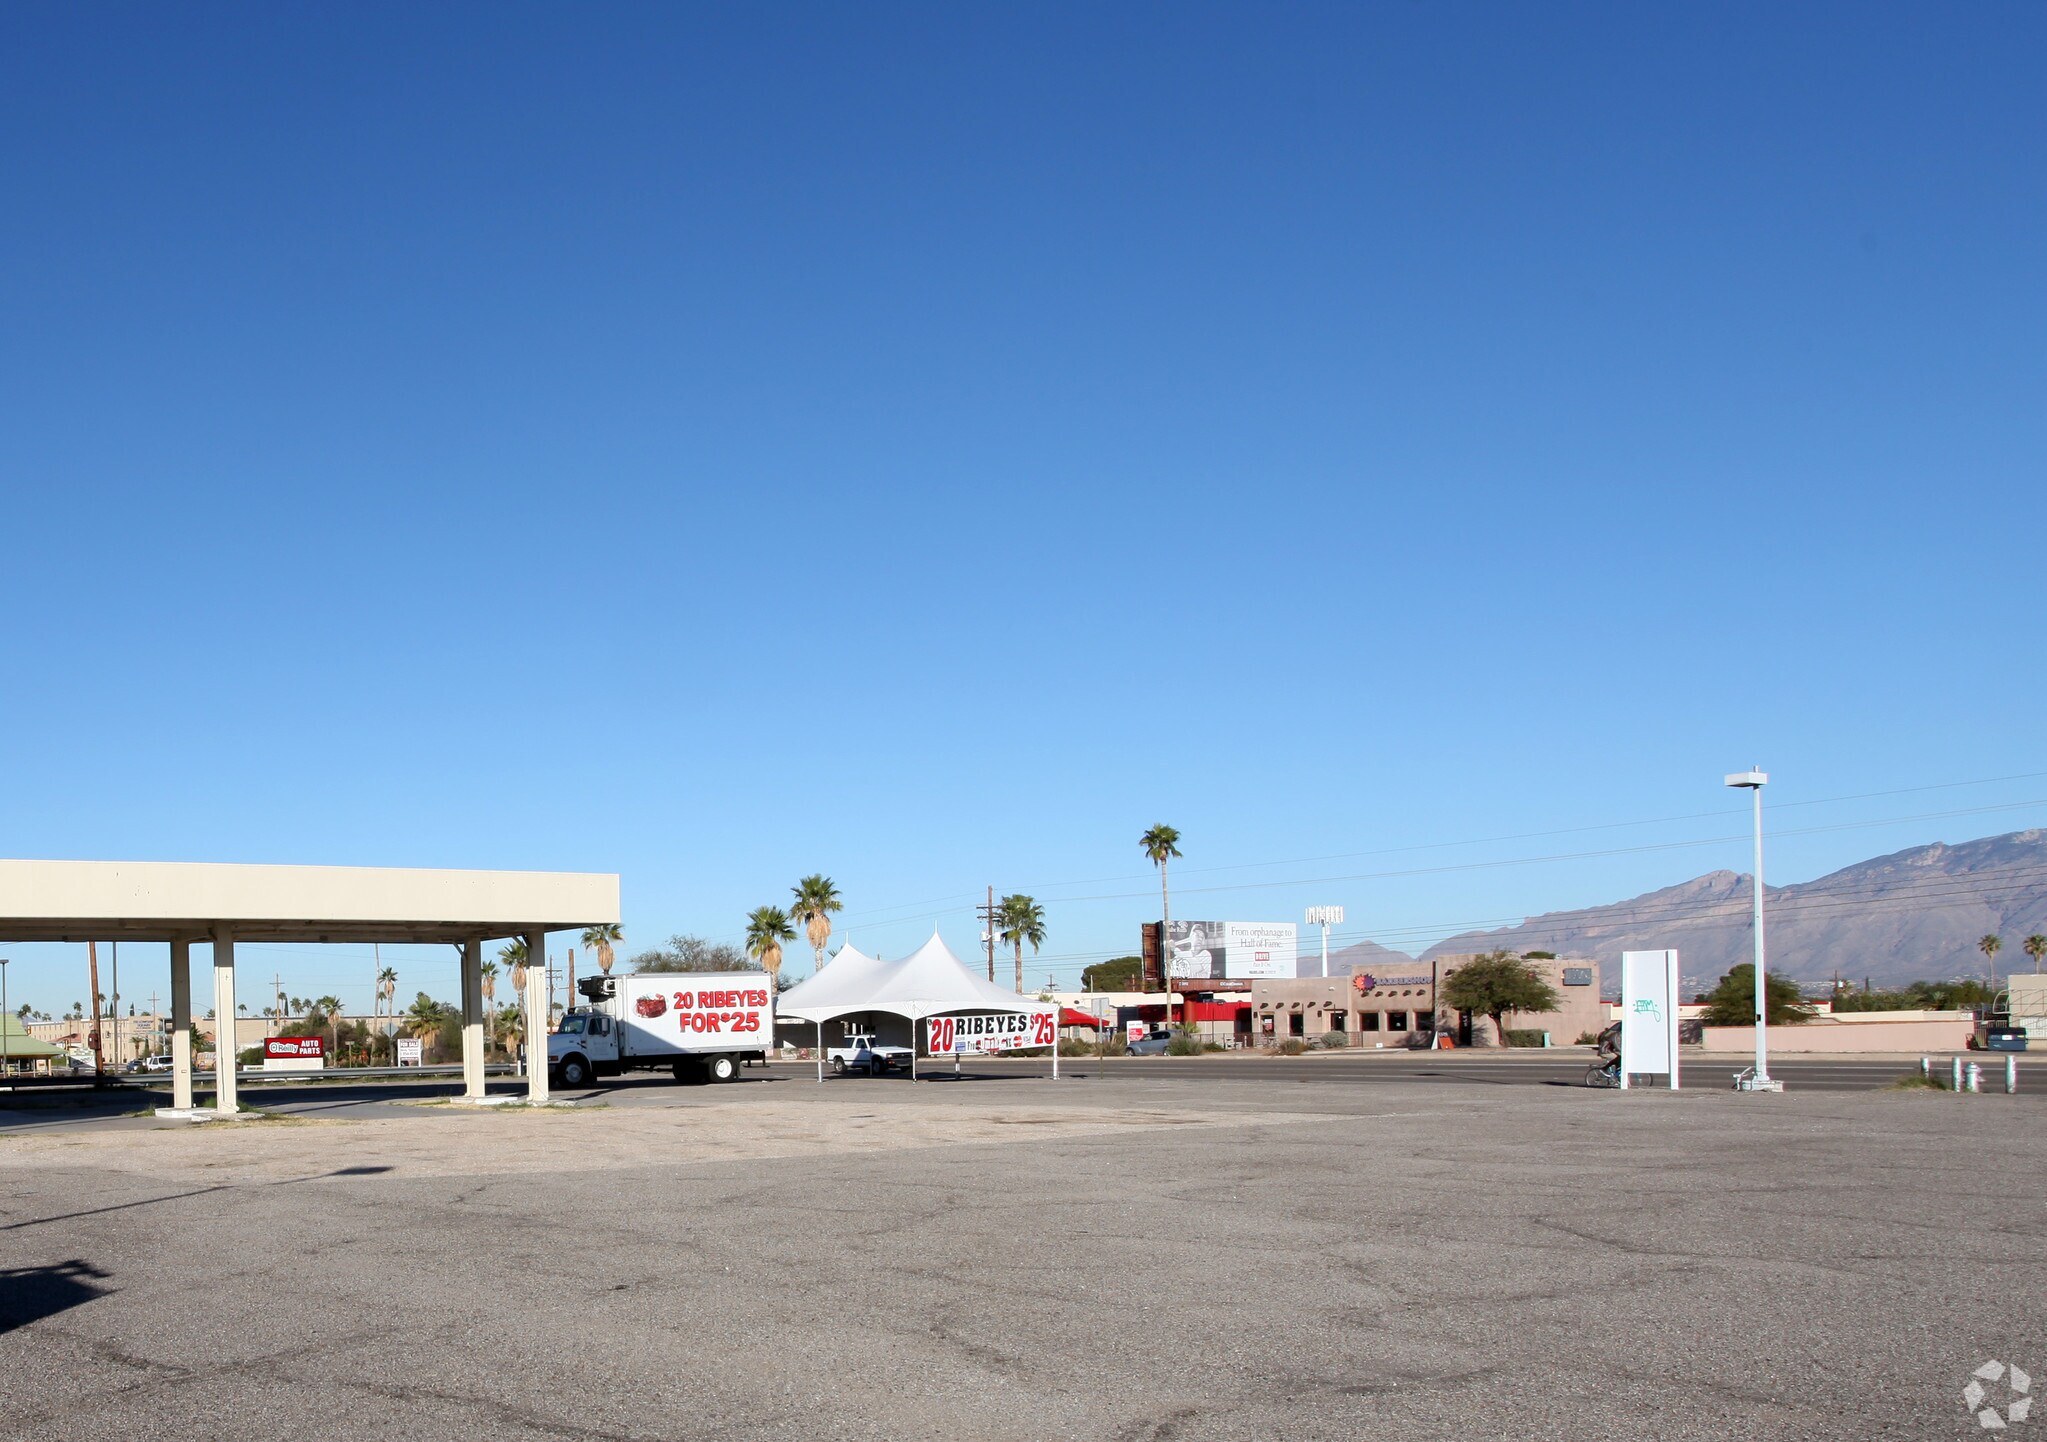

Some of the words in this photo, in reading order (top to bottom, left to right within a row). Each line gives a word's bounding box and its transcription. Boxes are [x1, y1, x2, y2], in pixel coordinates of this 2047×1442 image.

[1231, 926, 1249, 936] From
[1250, 926, 1284, 938] orphanage
[1285, 929, 1293, 937] to
[673, 991, 694, 1009] 20
[698, 989, 768, 1009] RIBEYES
[680, 1012, 721, 1033] FOR
[930, 1018, 954, 1052] 20
[955, 1015, 1027, 1036] RIBEYES
[1029, 1013, 1055, 1045] $25
[299, 1047, 321, 1055] PARTS
[301, 1040, 319, 1048] AUTO
